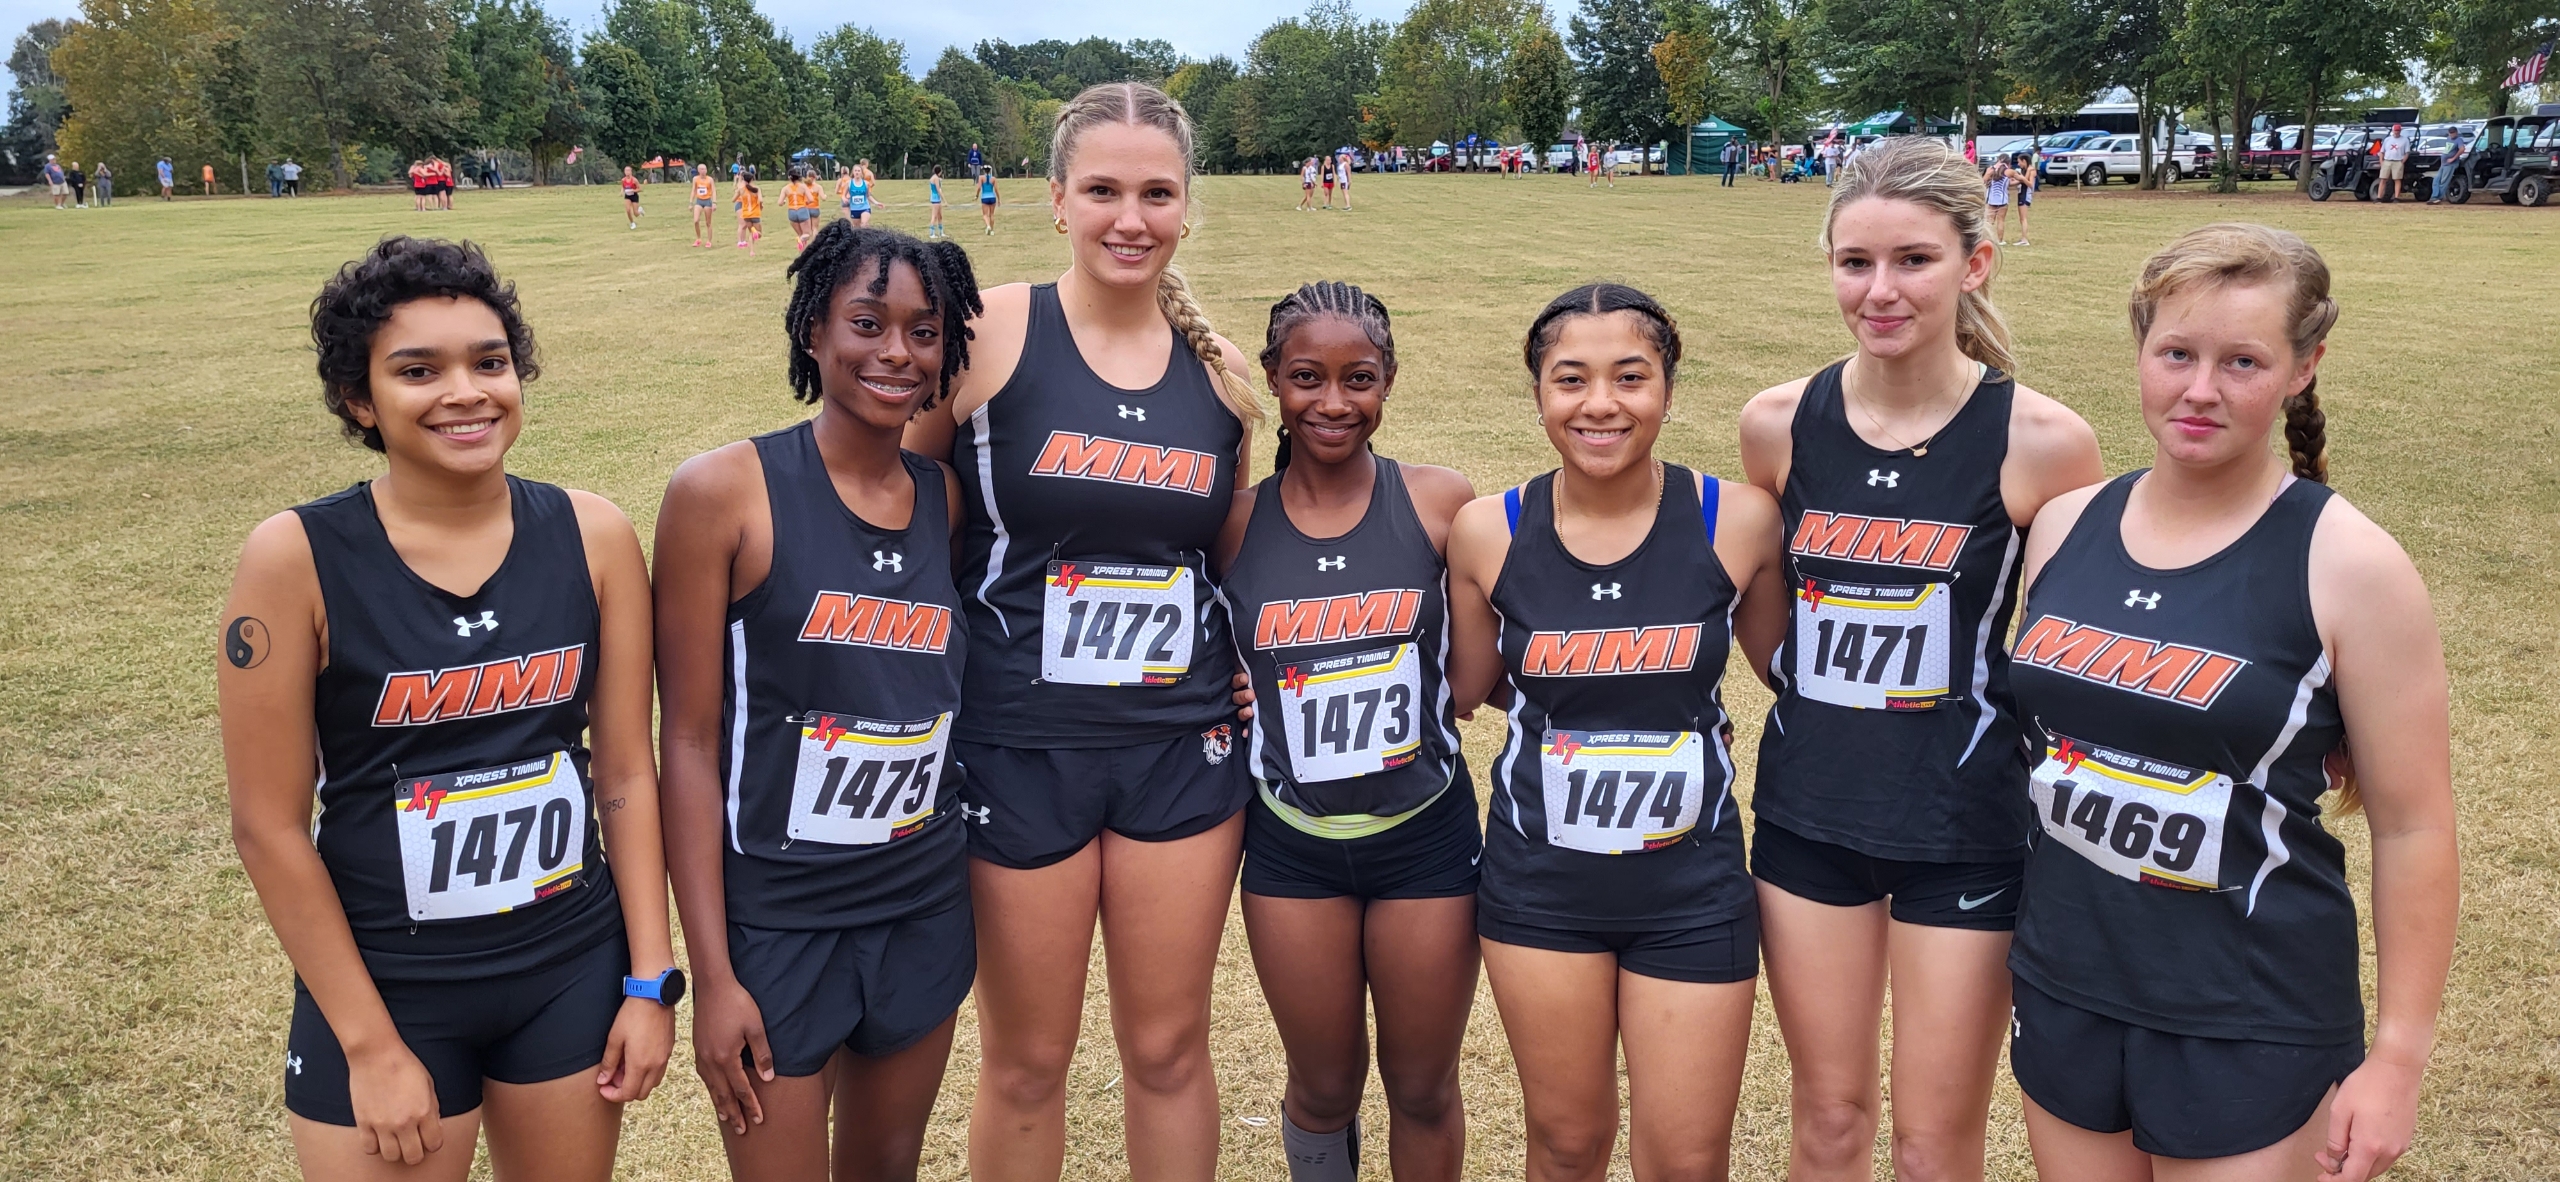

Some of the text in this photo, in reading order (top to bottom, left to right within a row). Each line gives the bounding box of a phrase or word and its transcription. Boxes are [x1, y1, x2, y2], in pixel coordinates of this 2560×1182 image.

[1028, 430, 1218, 498] MMI
[1789, 509, 1975, 573] MMI
[1052, 564, 1086, 597] XT
[1091, 565, 1169, 578] XPRESS TIMING
[1829, 583, 1915, 598] XPRESS TIMING
[1801, 578, 1825, 613] XT
[797, 590, 952, 655] MMI
[1060, 600, 1182, 662] 1472
[1254, 588, 1424, 651] MMI
[1312, 650, 1391, 672] XPRESS TIMING
[1521, 622, 1704, 677] MMI
[1814, 618, 1928, 687] 1471
[2012, 614, 2250, 711] MMI
[371, 642, 586, 728] MMI
[1283, 666, 1308, 697] XT
[808, 716, 847, 751] XT
[853, 720, 901, 733] XPRESS
[1300, 683, 1411, 759] 1473
[1587, 733, 1670, 744] XPRESS TIMING
[1547, 733, 1582, 766] XT
[2053, 738, 2086, 775] XT
[2091, 747, 2191, 780] XPRESS TIMING
[454, 759, 546, 788] XPRESS TIMING
[811, 751, 938, 819] 1475
[405, 781, 448, 819] XT
[1563, 768, 1688, 829] 1474
[428, 797, 573, 894] 1470
[2051, 778, 2207, 872] 1469
